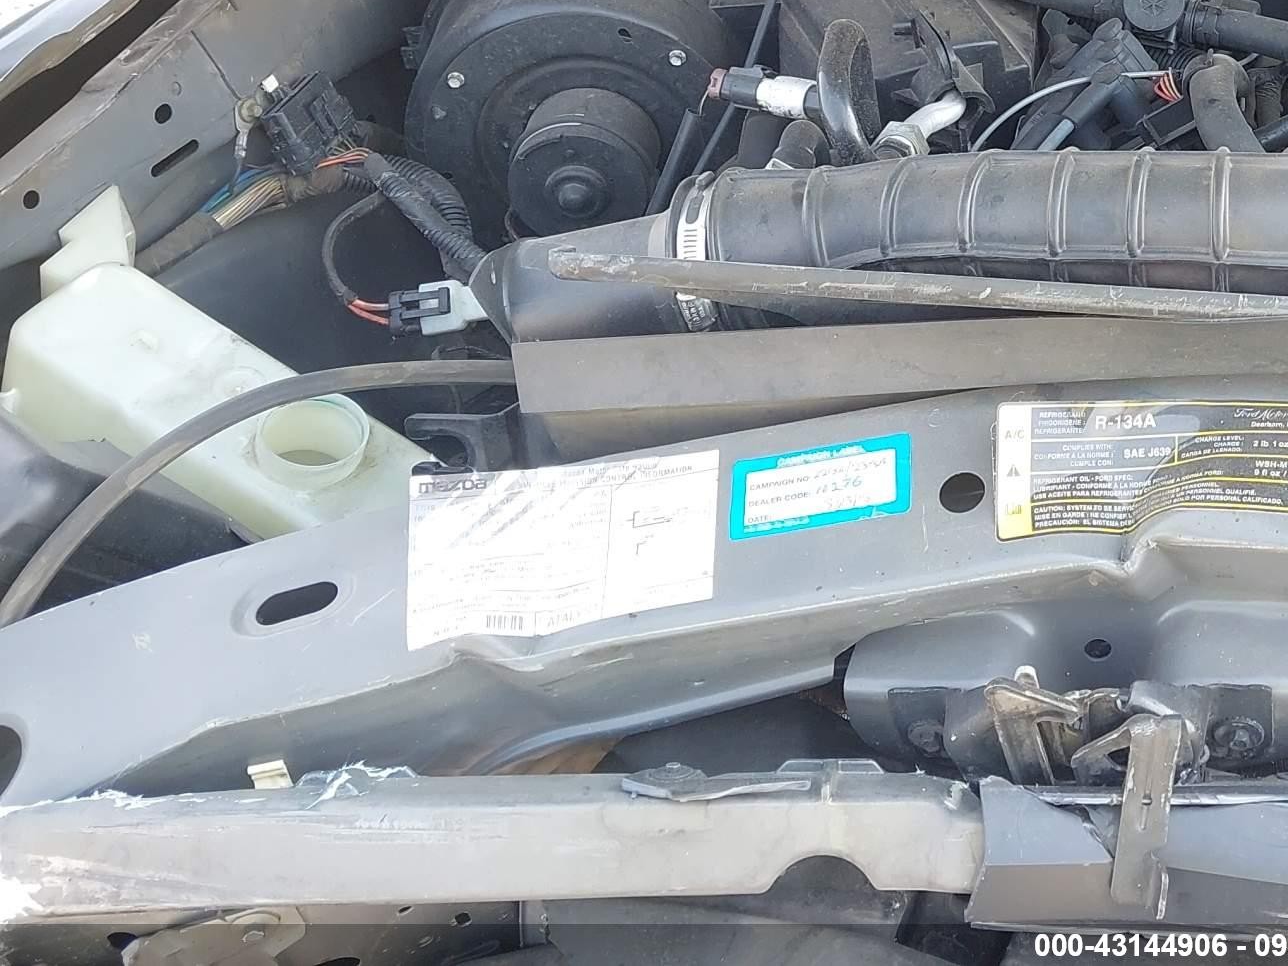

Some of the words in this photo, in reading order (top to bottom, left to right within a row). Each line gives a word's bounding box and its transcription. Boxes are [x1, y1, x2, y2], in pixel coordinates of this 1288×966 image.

[1095, 413, 1157, 430] R-134A
[1252, 440, 1259, 448] 2
[1260, 440, 1269, 448] lb
[1123, 447, 1146, 459] SAE
[1147, 446, 1171, 458] J639
[749, 477, 795, 491] CAMPAIGN
[748, 495, 782, 508] DEALER
